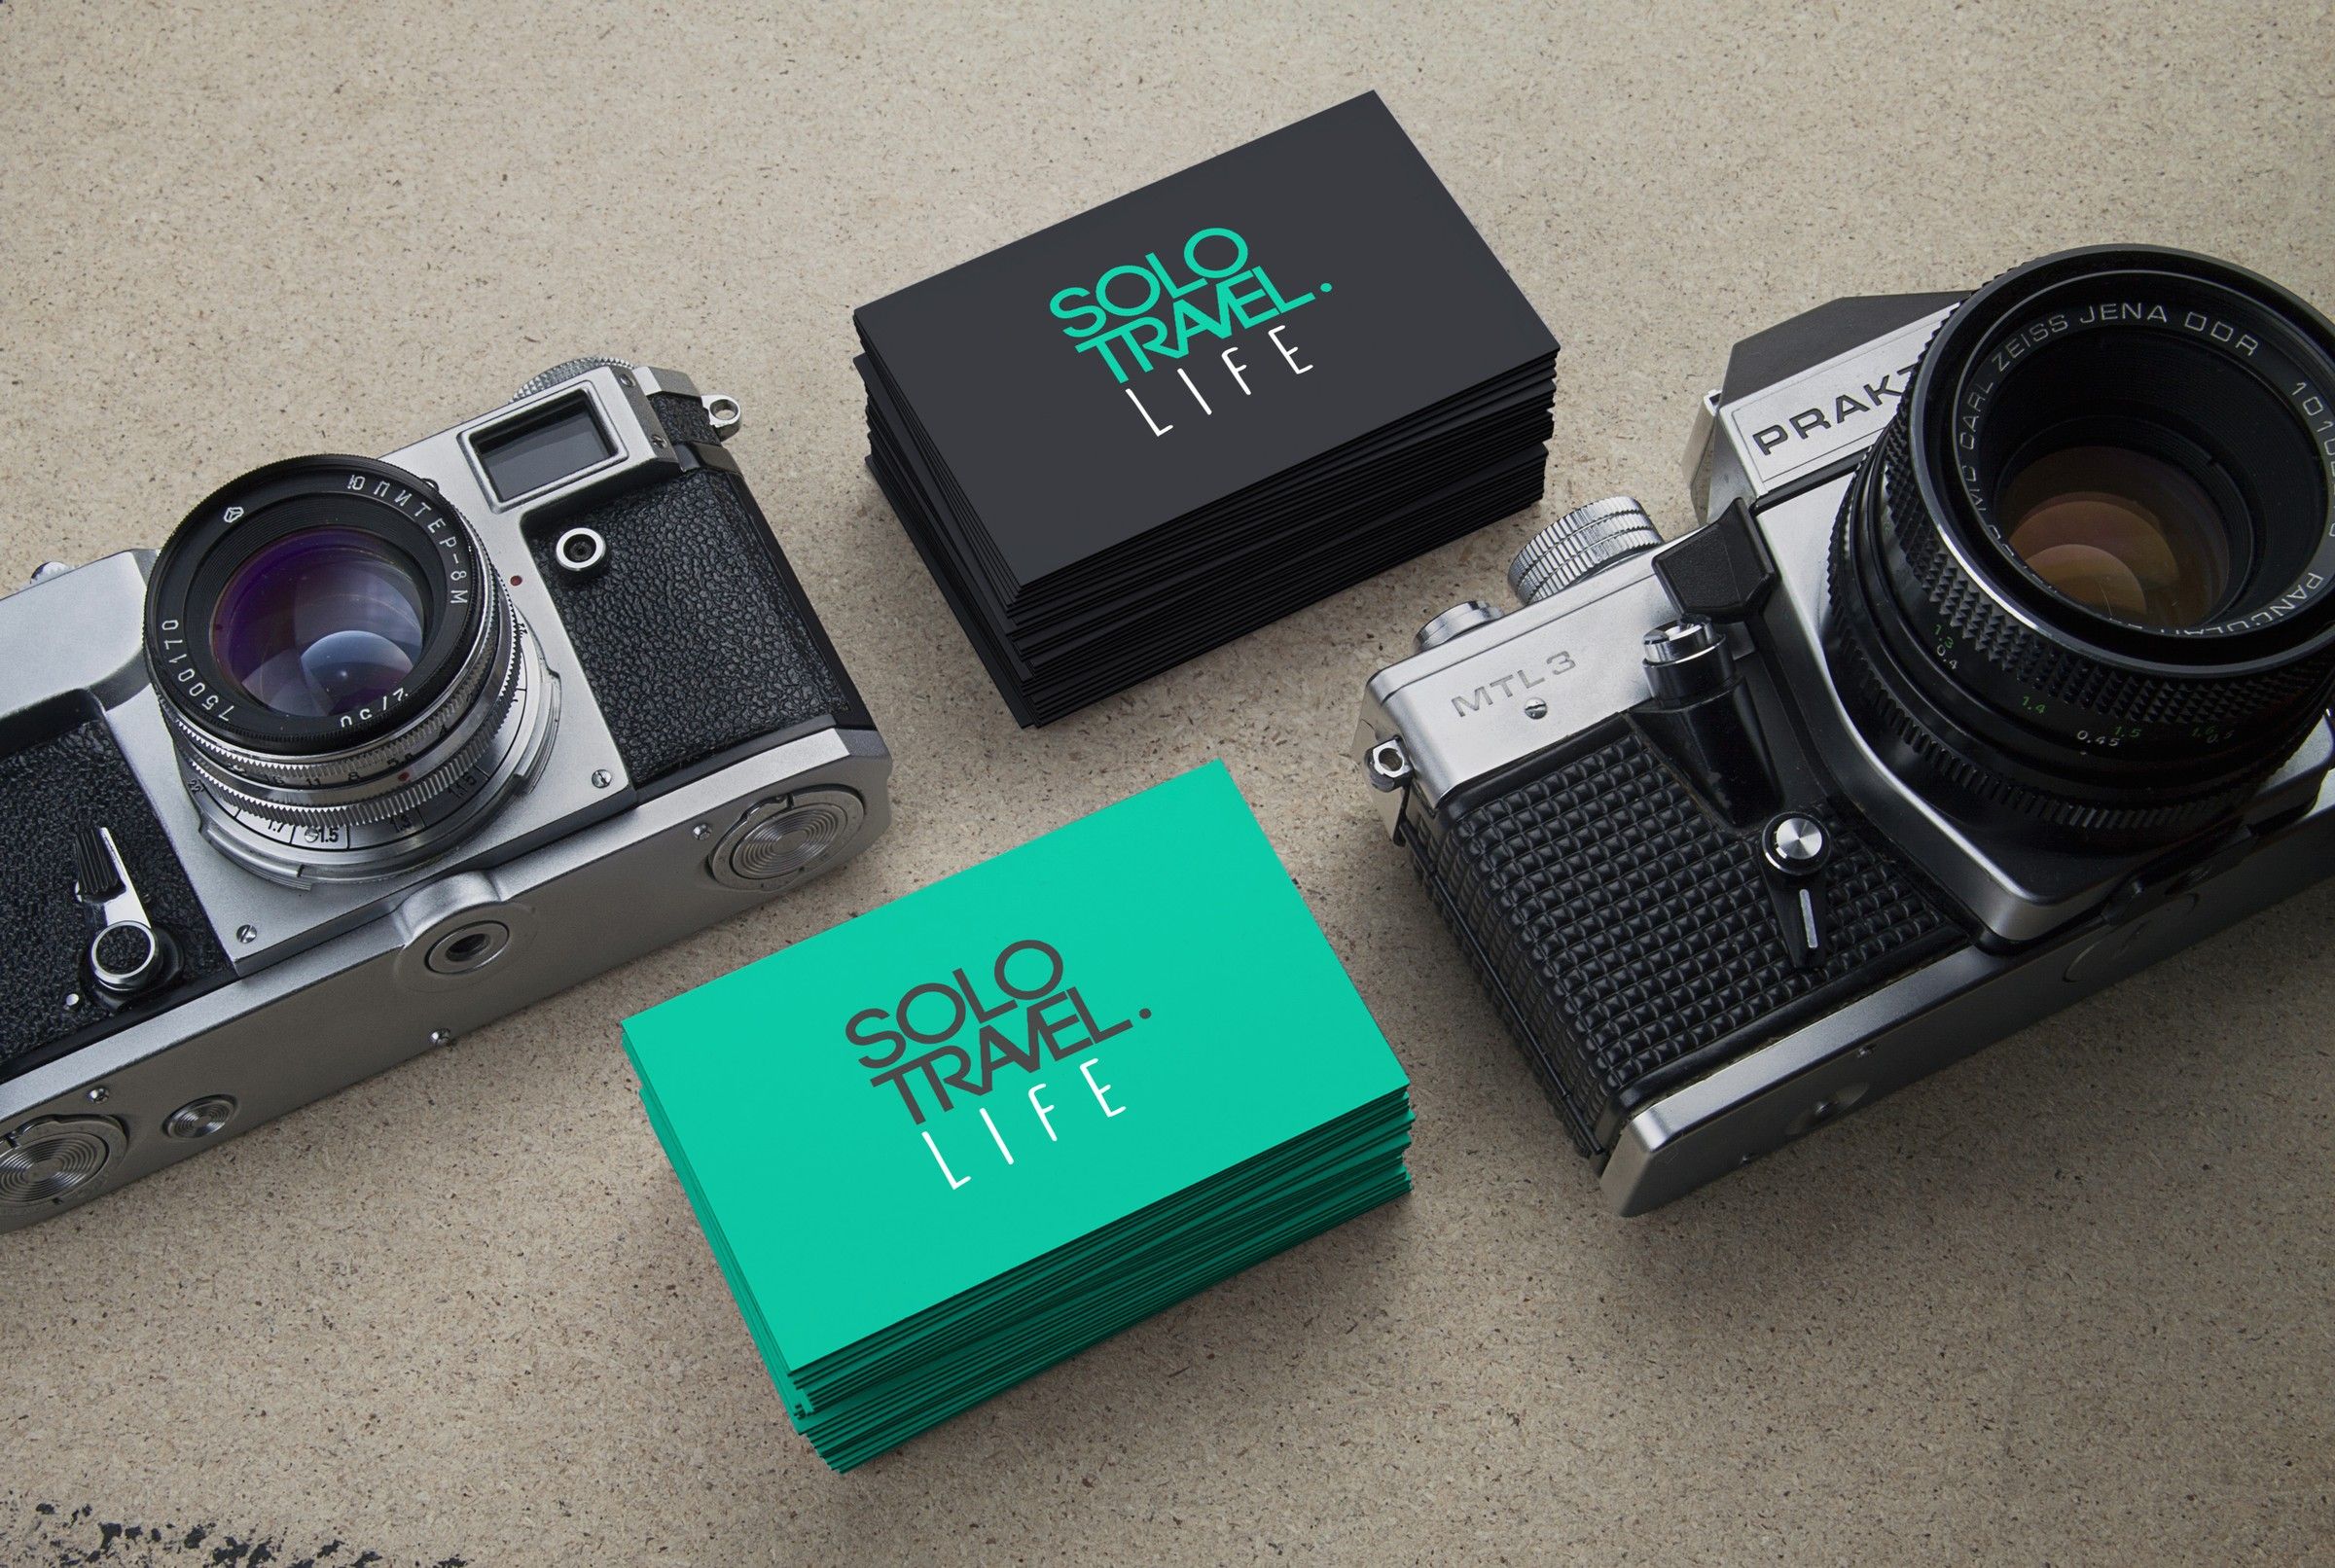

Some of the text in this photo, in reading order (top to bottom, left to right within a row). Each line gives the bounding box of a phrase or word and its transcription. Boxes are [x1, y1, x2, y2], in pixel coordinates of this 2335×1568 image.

[1050, 228, 1248, 338] SOLO
[1125, 325, 1313, 437] LIFE
[1959, 382, 1994, 449] CARL
[1992, 314, 2069, 372] ZEISS
[2079, 303, 2168, 324] JENA
[2183, 311, 2259, 357] DDR
[161, 620, 234, 722] 7500170
[1936, 644, 1958, 670] 0.4
[2076, 730, 2121, 747] 0.45
[2113, 726, 2143, 738] 1.5
[318, 827, 340, 843] 1.5
[845, 940, 1063, 1069] SOLO
[921, 1058, 1127, 1190] LIFE
